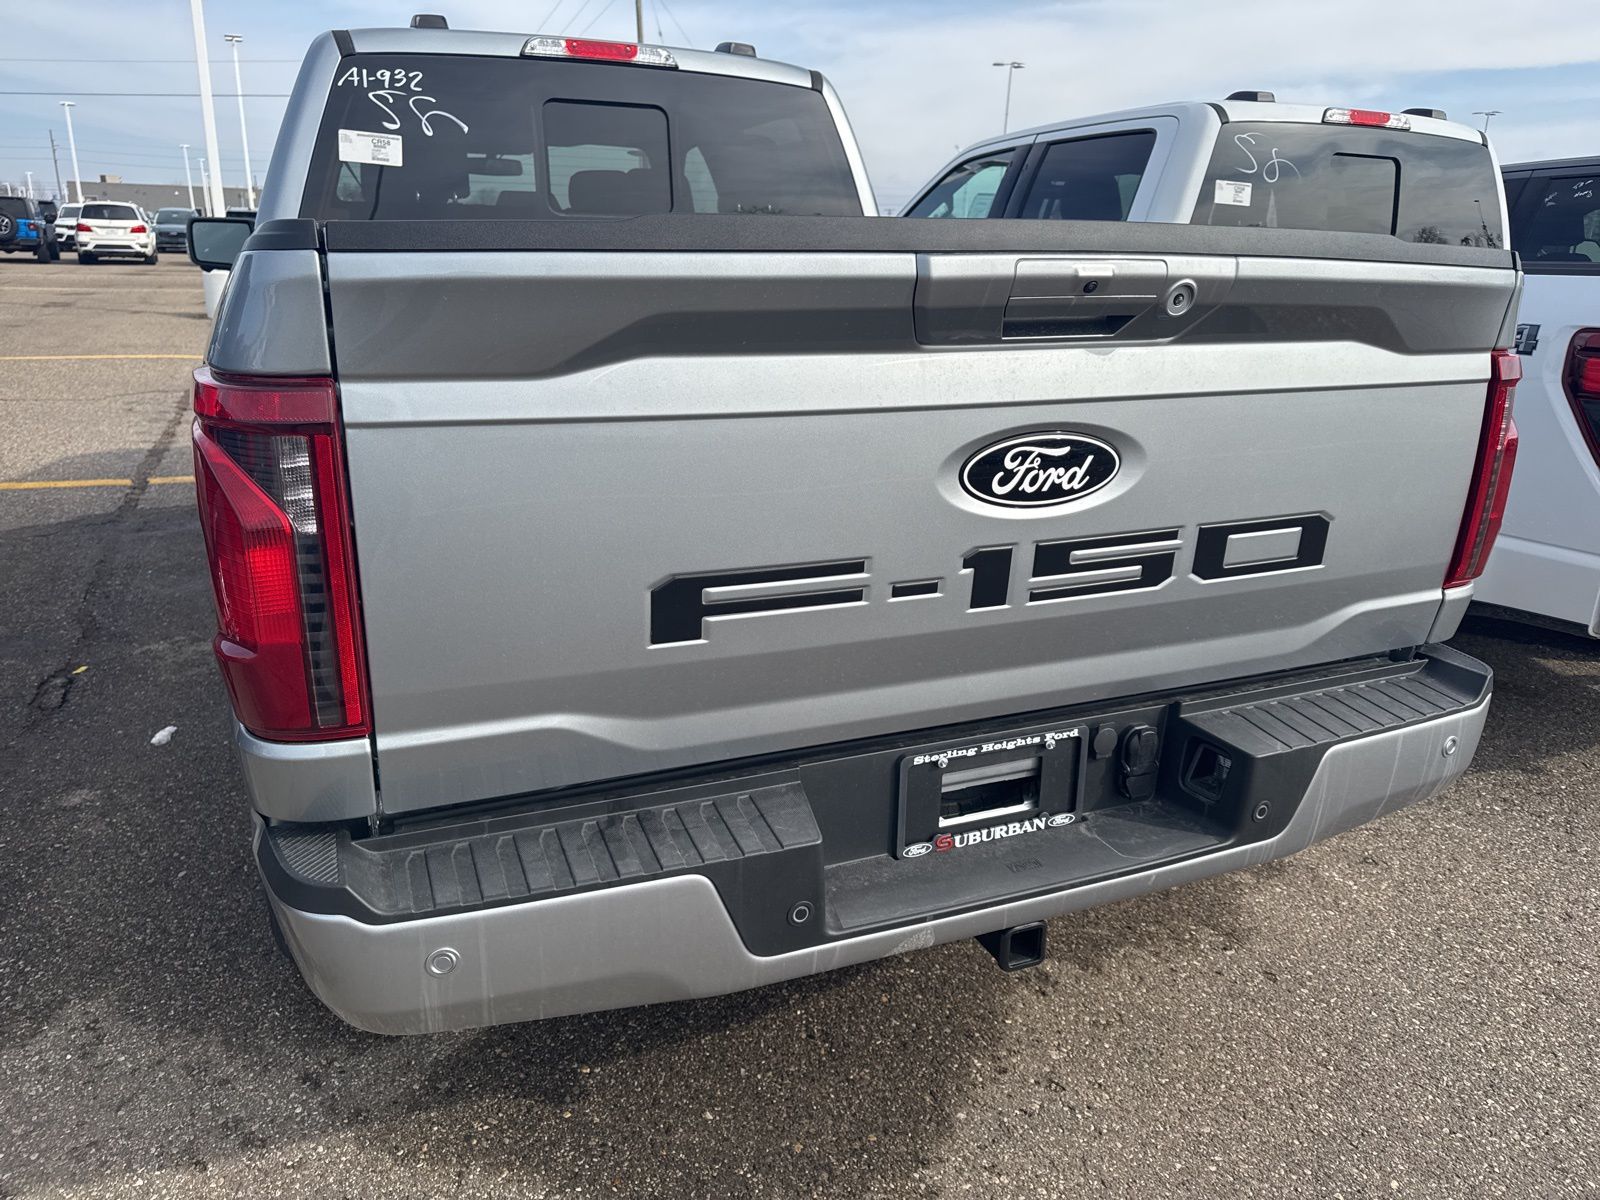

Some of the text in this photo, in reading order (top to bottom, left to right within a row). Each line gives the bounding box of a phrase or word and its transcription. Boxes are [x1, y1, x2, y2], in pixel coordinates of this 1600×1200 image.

[992, 446, 1095, 495] Ford
[647, 511, 1332, 648] F-150
[913, 729, 1079, 766] Sterling Heights Ford
[935, 817, 1047, 852] SUBURBAN
